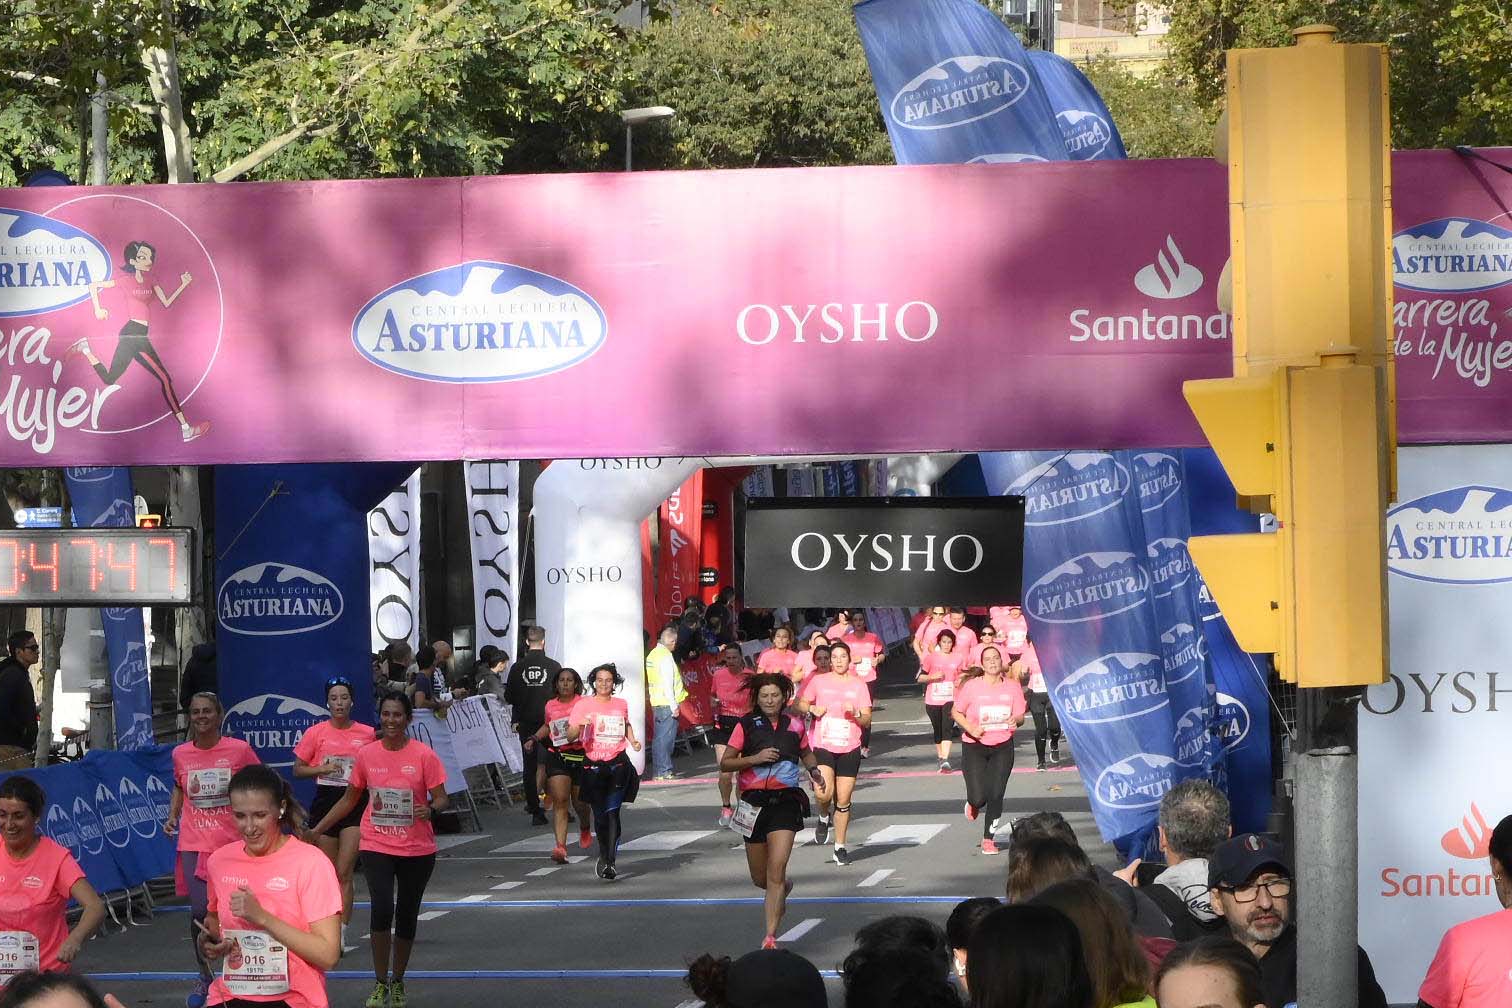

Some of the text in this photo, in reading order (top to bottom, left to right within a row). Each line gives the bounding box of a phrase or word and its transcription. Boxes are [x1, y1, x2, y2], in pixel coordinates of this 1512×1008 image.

[14, 244, 88, 257] LECHERA
[1409, 242, 1459, 252] CENTRAL
[410, 300, 580, 318] CENTRAL LECHERA
[372, 307, 587, 353] ASTURIANA
[736, 300, 940, 346] OYSHO
[1418, 334, 1437, 357] la
[1416, 519, 1482, 531] CENTRAL
[791, 532, 984, 573] OYSHO
[547, 565, 622, 584] OYSHO
[281, 587, 330, 596] LECHERA
[221, 592, 335, 620] ASTURIANA
[529, 671, 542, 680] BP
[0, 953, 18, 961] 016
[244, 955, 265, 965] 016
